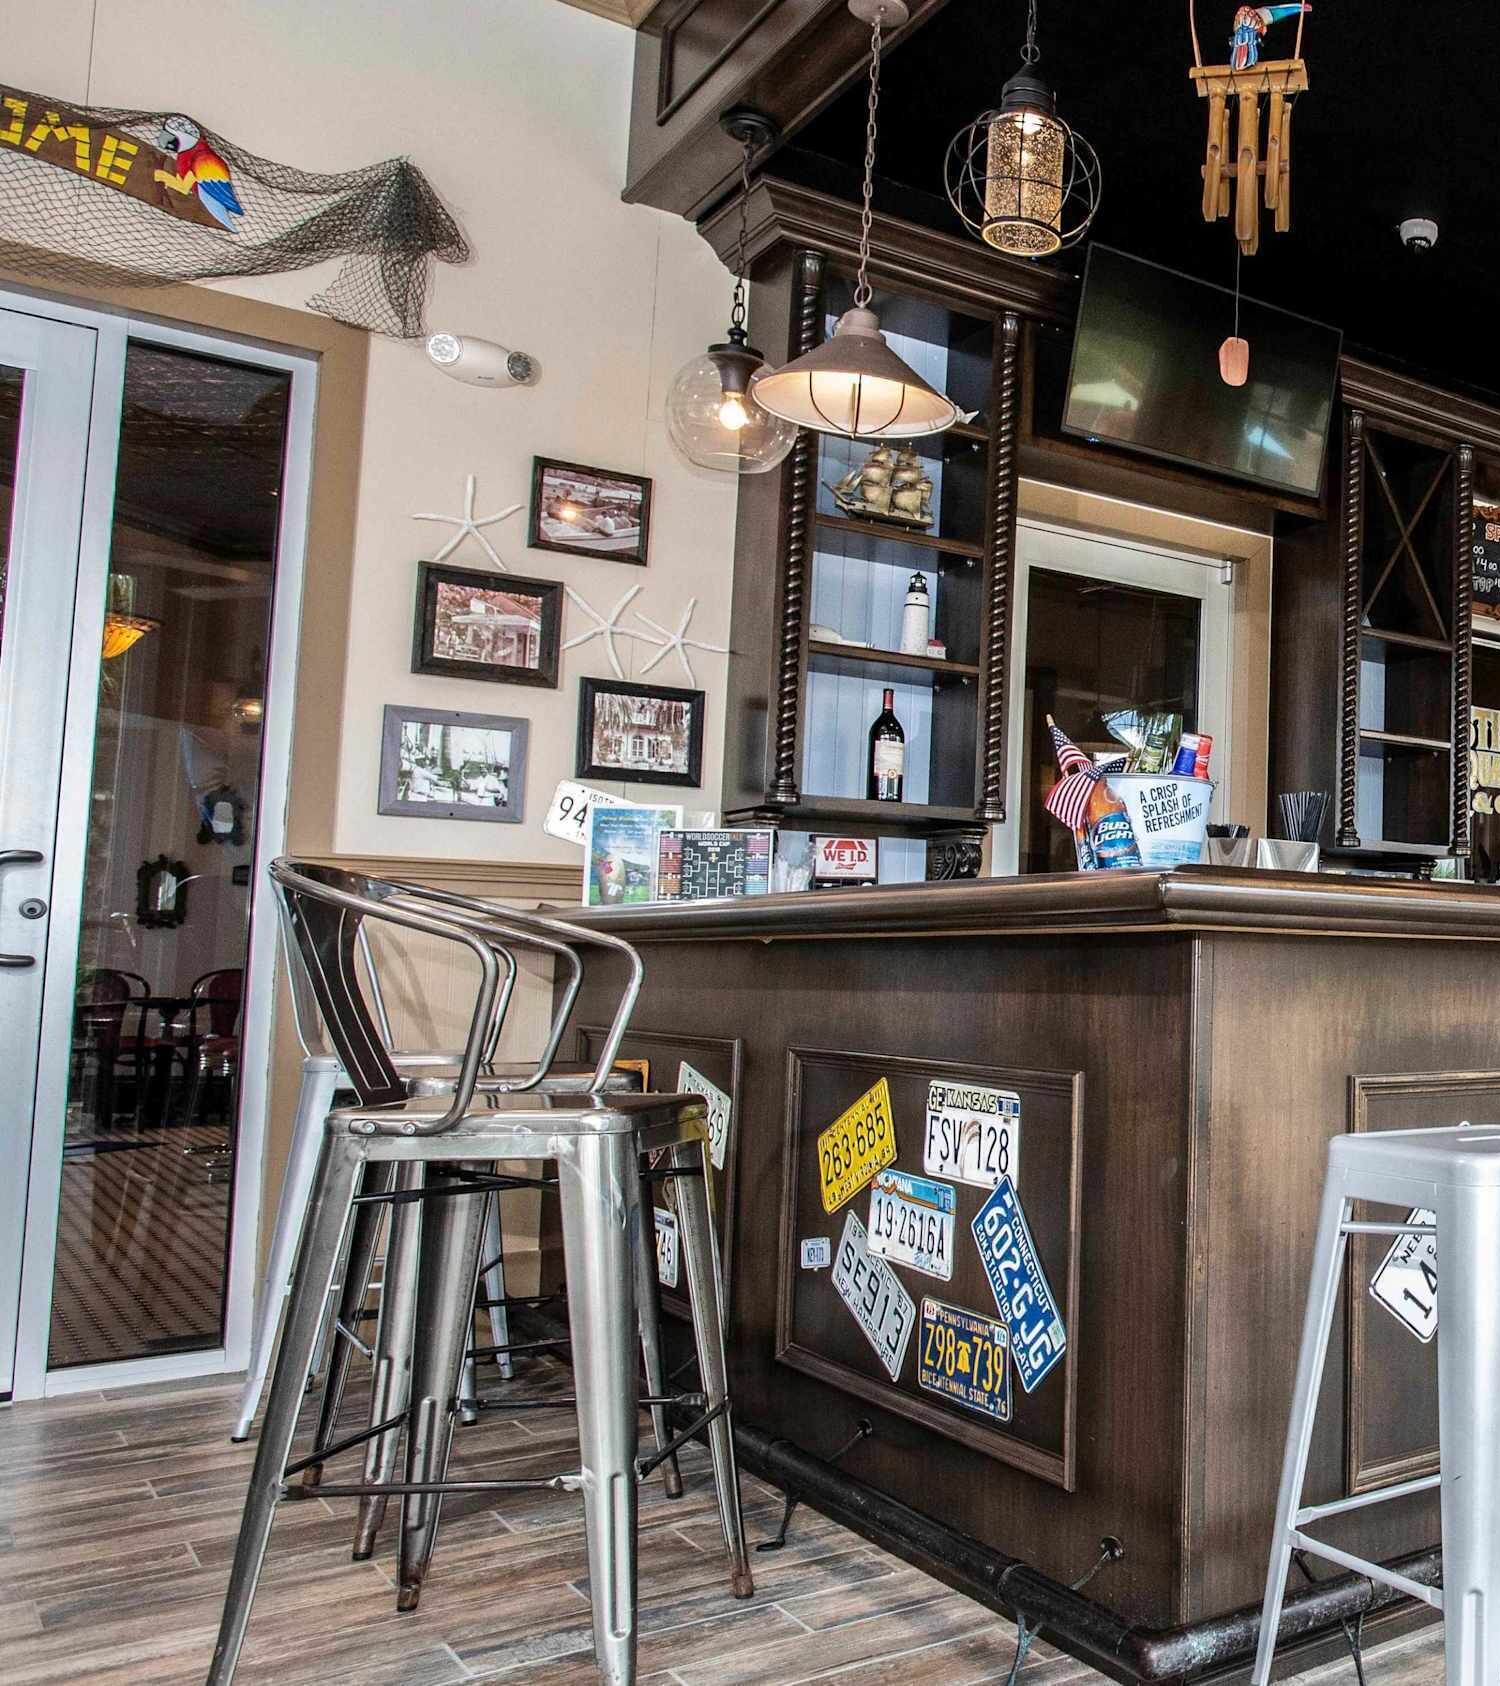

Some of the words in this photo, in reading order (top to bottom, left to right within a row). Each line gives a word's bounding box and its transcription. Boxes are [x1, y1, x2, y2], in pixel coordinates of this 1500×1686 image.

[1139, 791, 1146, 804] A
[1150, 783, 1178, 801] CRISP
[1142, 798, 1179, 818] SPLASH
[1182, 793, 1192, 806] OF
[1098, 821, 1130, 834] BUD
[1145, 803, 1203, 833] REFRESHMENT
[1094, 831, 1133, 847] LIGHT
[823, 850, 846, 862] WE
[946, 1088, 997, 1114] KANSAS
[928, 1115, 963, 1165] FSV
[978, 1123, 1009, 1174] 128
[1010, 1216, 1051, 1313] CONNECTICUT
[976, 1223, 1013, 1322] CONSTITUTION
[1012, 1333, 1033, 1380] STATE
[853, 1300, 893, 1367] HAMPSHIRE
[939, 1309, 990, 1337] PENNSYLVANIA
[921, 1369, 968, 1399] BICENTENNIAL
[968, 1387, 991, 1407] STATE
